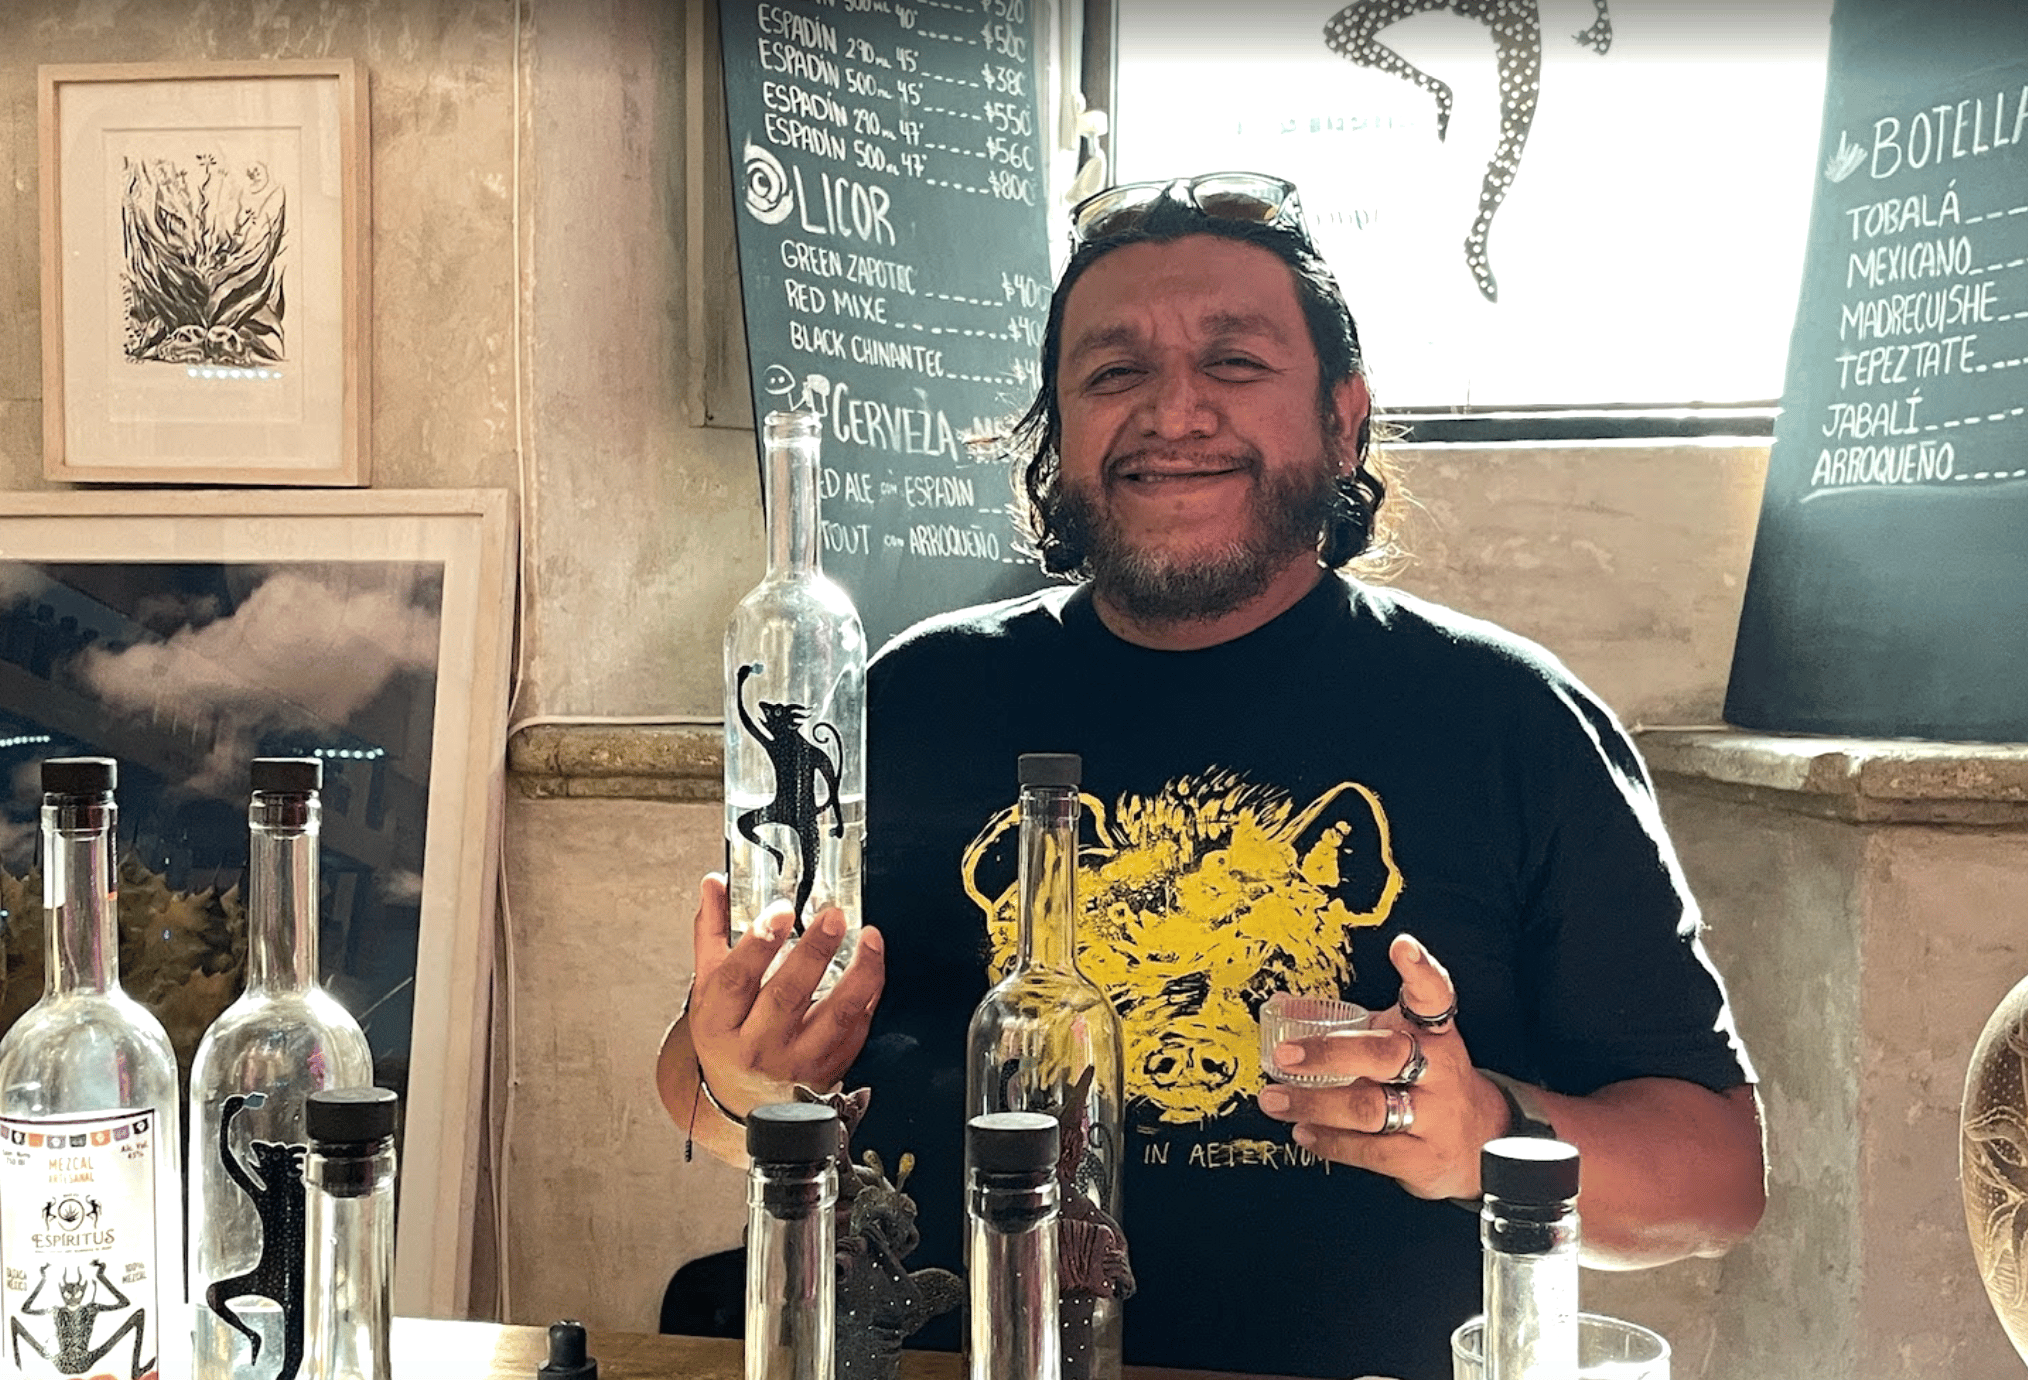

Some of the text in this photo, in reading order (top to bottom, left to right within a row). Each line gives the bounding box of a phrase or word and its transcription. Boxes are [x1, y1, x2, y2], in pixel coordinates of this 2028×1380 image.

[793, 165, 895, 246] LICOR
[1846, 179, 1960, 241] TOBALÁ
[780, 239, 843, 278] GREEN
[846, 253, 917, 296] ZAPOTEC
[1846, 235, 1972, 289] MEXICANO
[785, 278, 826, 314] RED
[832, 288, 887, 325] MIXE
[1840, 281, 1998, 341] MADRECUISHE
[789, 320, 847, 359] BLACK
[851, 334, 945, 378] CHINANTEC
[1835, 334, 1978, 390] TEPEZTATE
[833, 383, 959, 461] CERVEZA
[1822, 387, 1923, 440] JABALÍ
[820, 467, 841, 500] ED
[845, 471, 874, 505] ALE
[1811, 440, 1955, 486] ARROQUEÑO
[821, 520, 871, 555] TOUT
[910, 524, 999, 561] ARROQUEÑO
[49, 1156, 94, 1171] MEZCAL
[1144, 1142, 1170, 1164] IN
